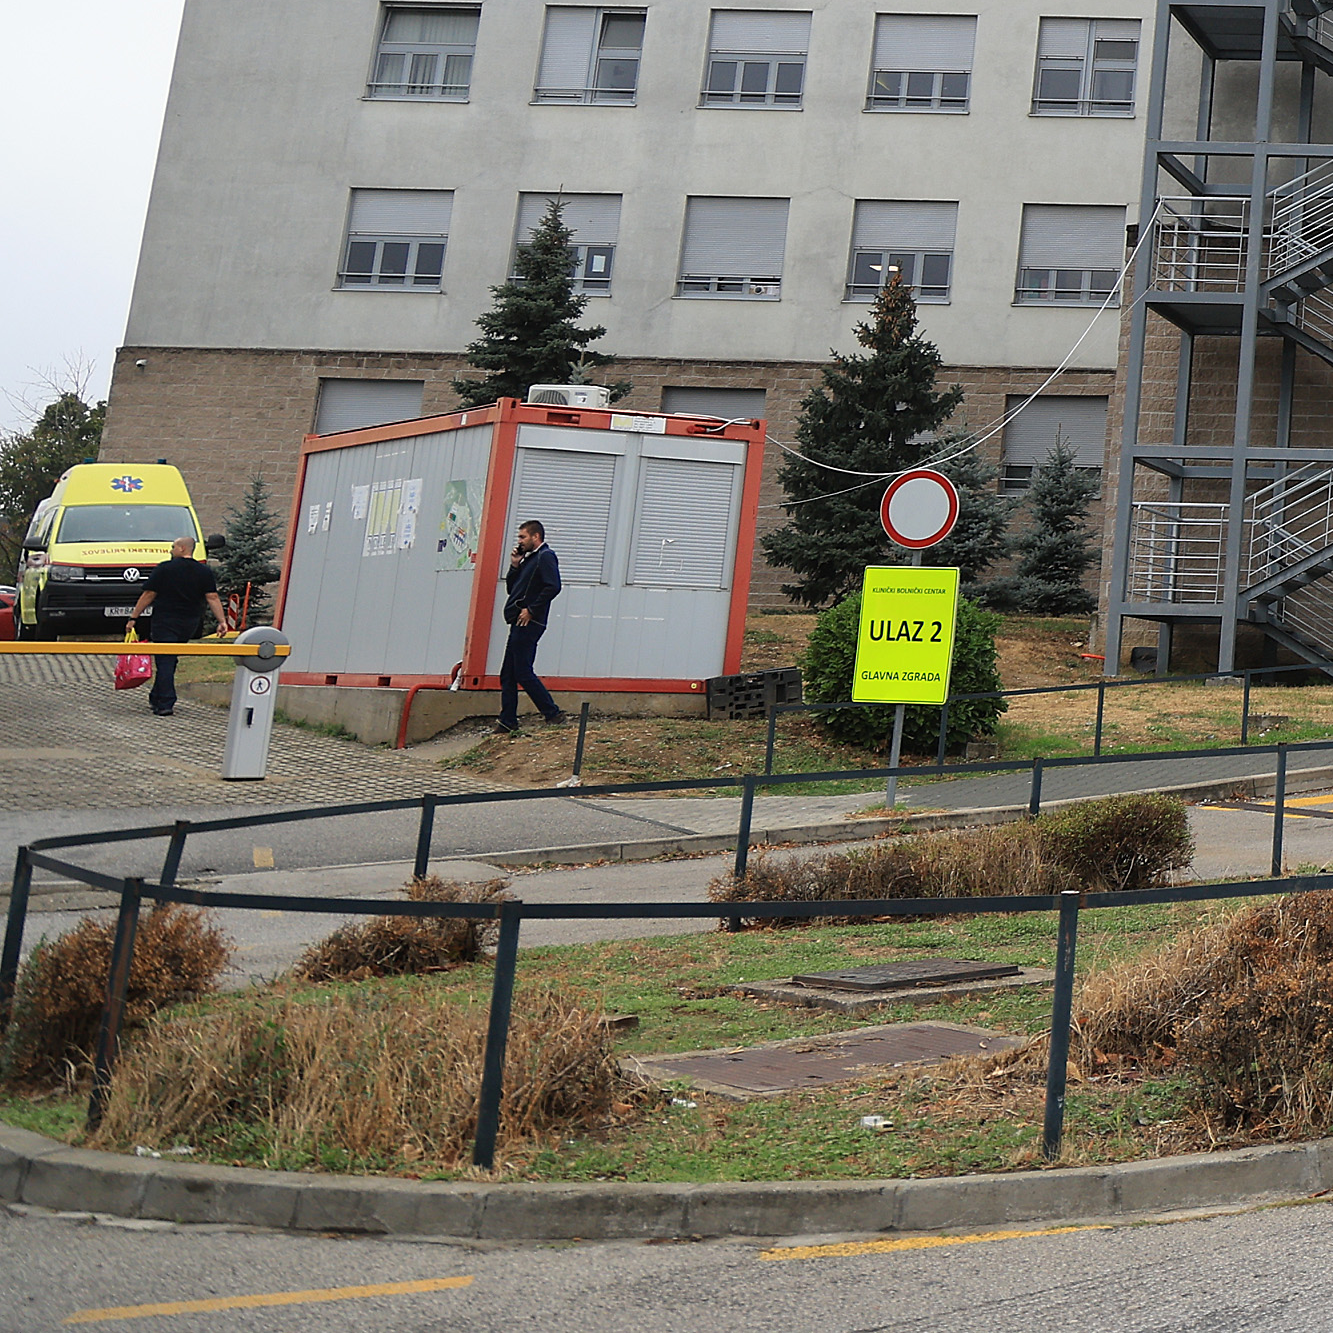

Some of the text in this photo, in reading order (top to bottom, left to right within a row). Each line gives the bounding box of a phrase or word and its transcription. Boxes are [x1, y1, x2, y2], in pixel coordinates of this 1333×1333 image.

[872, 586, 895, 594] KLINIČKI
[869, 620, 943, 642] ULAZ 2
[861, 670, 941, 681] GLAVNA ZGRADA
